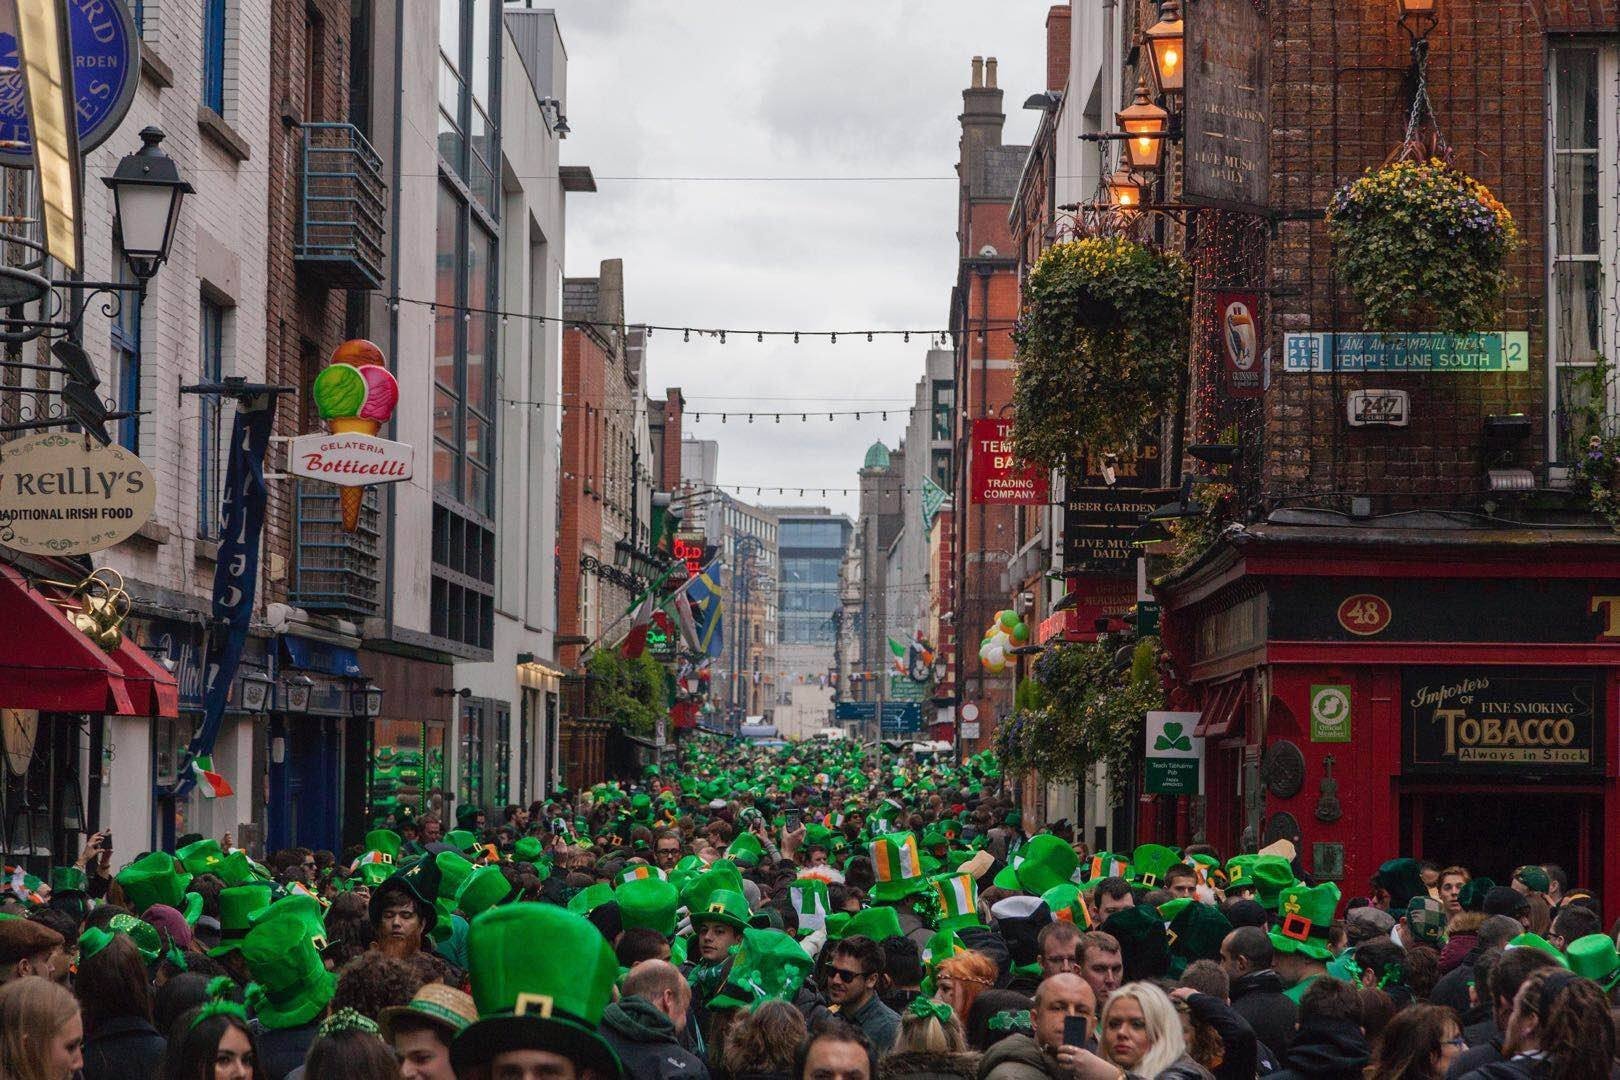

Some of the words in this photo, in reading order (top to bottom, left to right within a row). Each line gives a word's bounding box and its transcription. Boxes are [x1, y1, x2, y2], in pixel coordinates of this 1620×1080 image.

[1508, 342, 1522, 361] 2
[1394, 353, 1432, 367] LANE
[1439, 353, 1490, 367] SOUTH
[320, 441, 385, 455] GELATERIA
[302, 453, 405, 476] Botticelli
[987, 479, 1034, 489] TRADING
[984, 489, 1036, 499] COMPANY
[66, 507, 98, 520] IRISH
[101, 507, 133, 520] FOOD
[1069, 503, 1101, 511] BEER
[1104, 503, 1157, 513] GARDEN
[1074, 539, 1104, 548] LIVE
[1093, 549, 1132, 559] DAILY
[1346, 600, 1380, 625] 48
[1410, 677, 1490, 708] Importers
[1460, 695, 1474, 704] OF
[1481, 702, 1511, 714] FINE
[1513, 702, 1574, 714] SMOKING
[1461, 748, 1515, 761] Always
[1523, 748, 1536, 760] in
